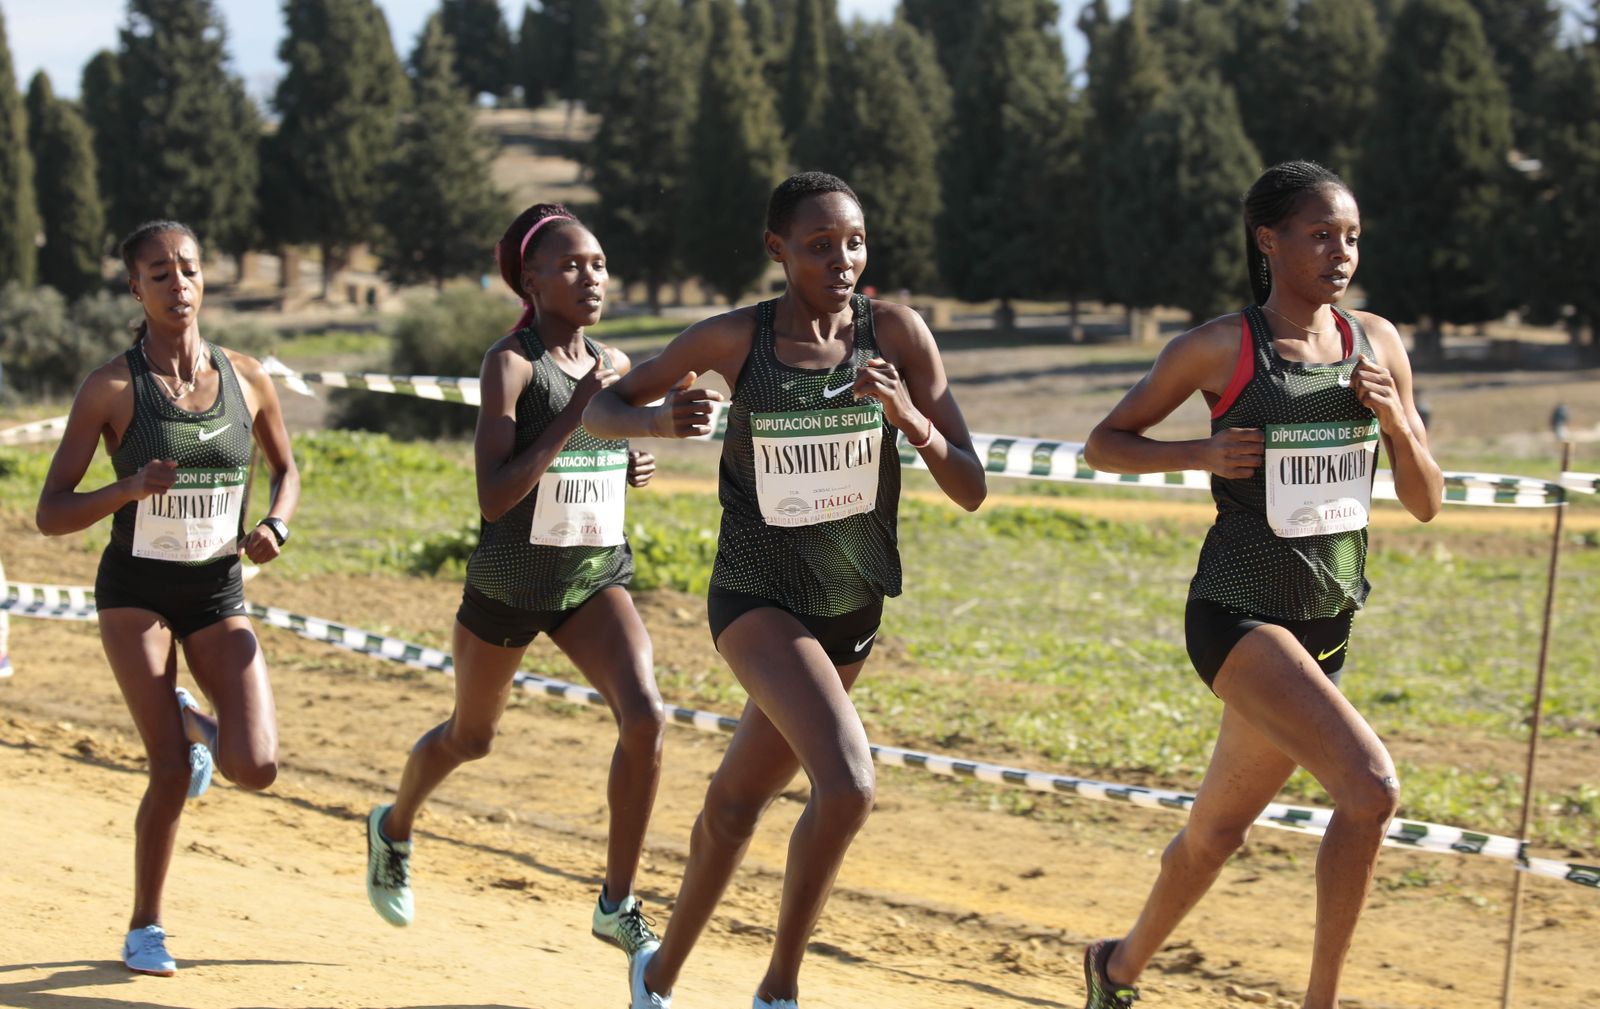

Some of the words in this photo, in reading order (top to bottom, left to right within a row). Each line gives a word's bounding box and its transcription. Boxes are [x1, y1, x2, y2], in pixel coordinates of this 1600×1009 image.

[824, 415, 838, 428] DE
[841, 411, 879, 427] SEVILLA
[1338, 427, 1351, 440] DE
[550, 456, 595, 467] IPUTACION
[597, 456, 606, 467] DE
[761, 441, 840, 475] YASMINE
[845, 436, 874, 468] CAN
[1279, 449, 1366, 485] CHEPKOECH
[199, 473, 211, 484] DE
[214, 471, 243, 484] SEVILLA
[814, 492, 863, 510] ITÁLICA
[1324, 506, 1362, 520] ITÁLIC
